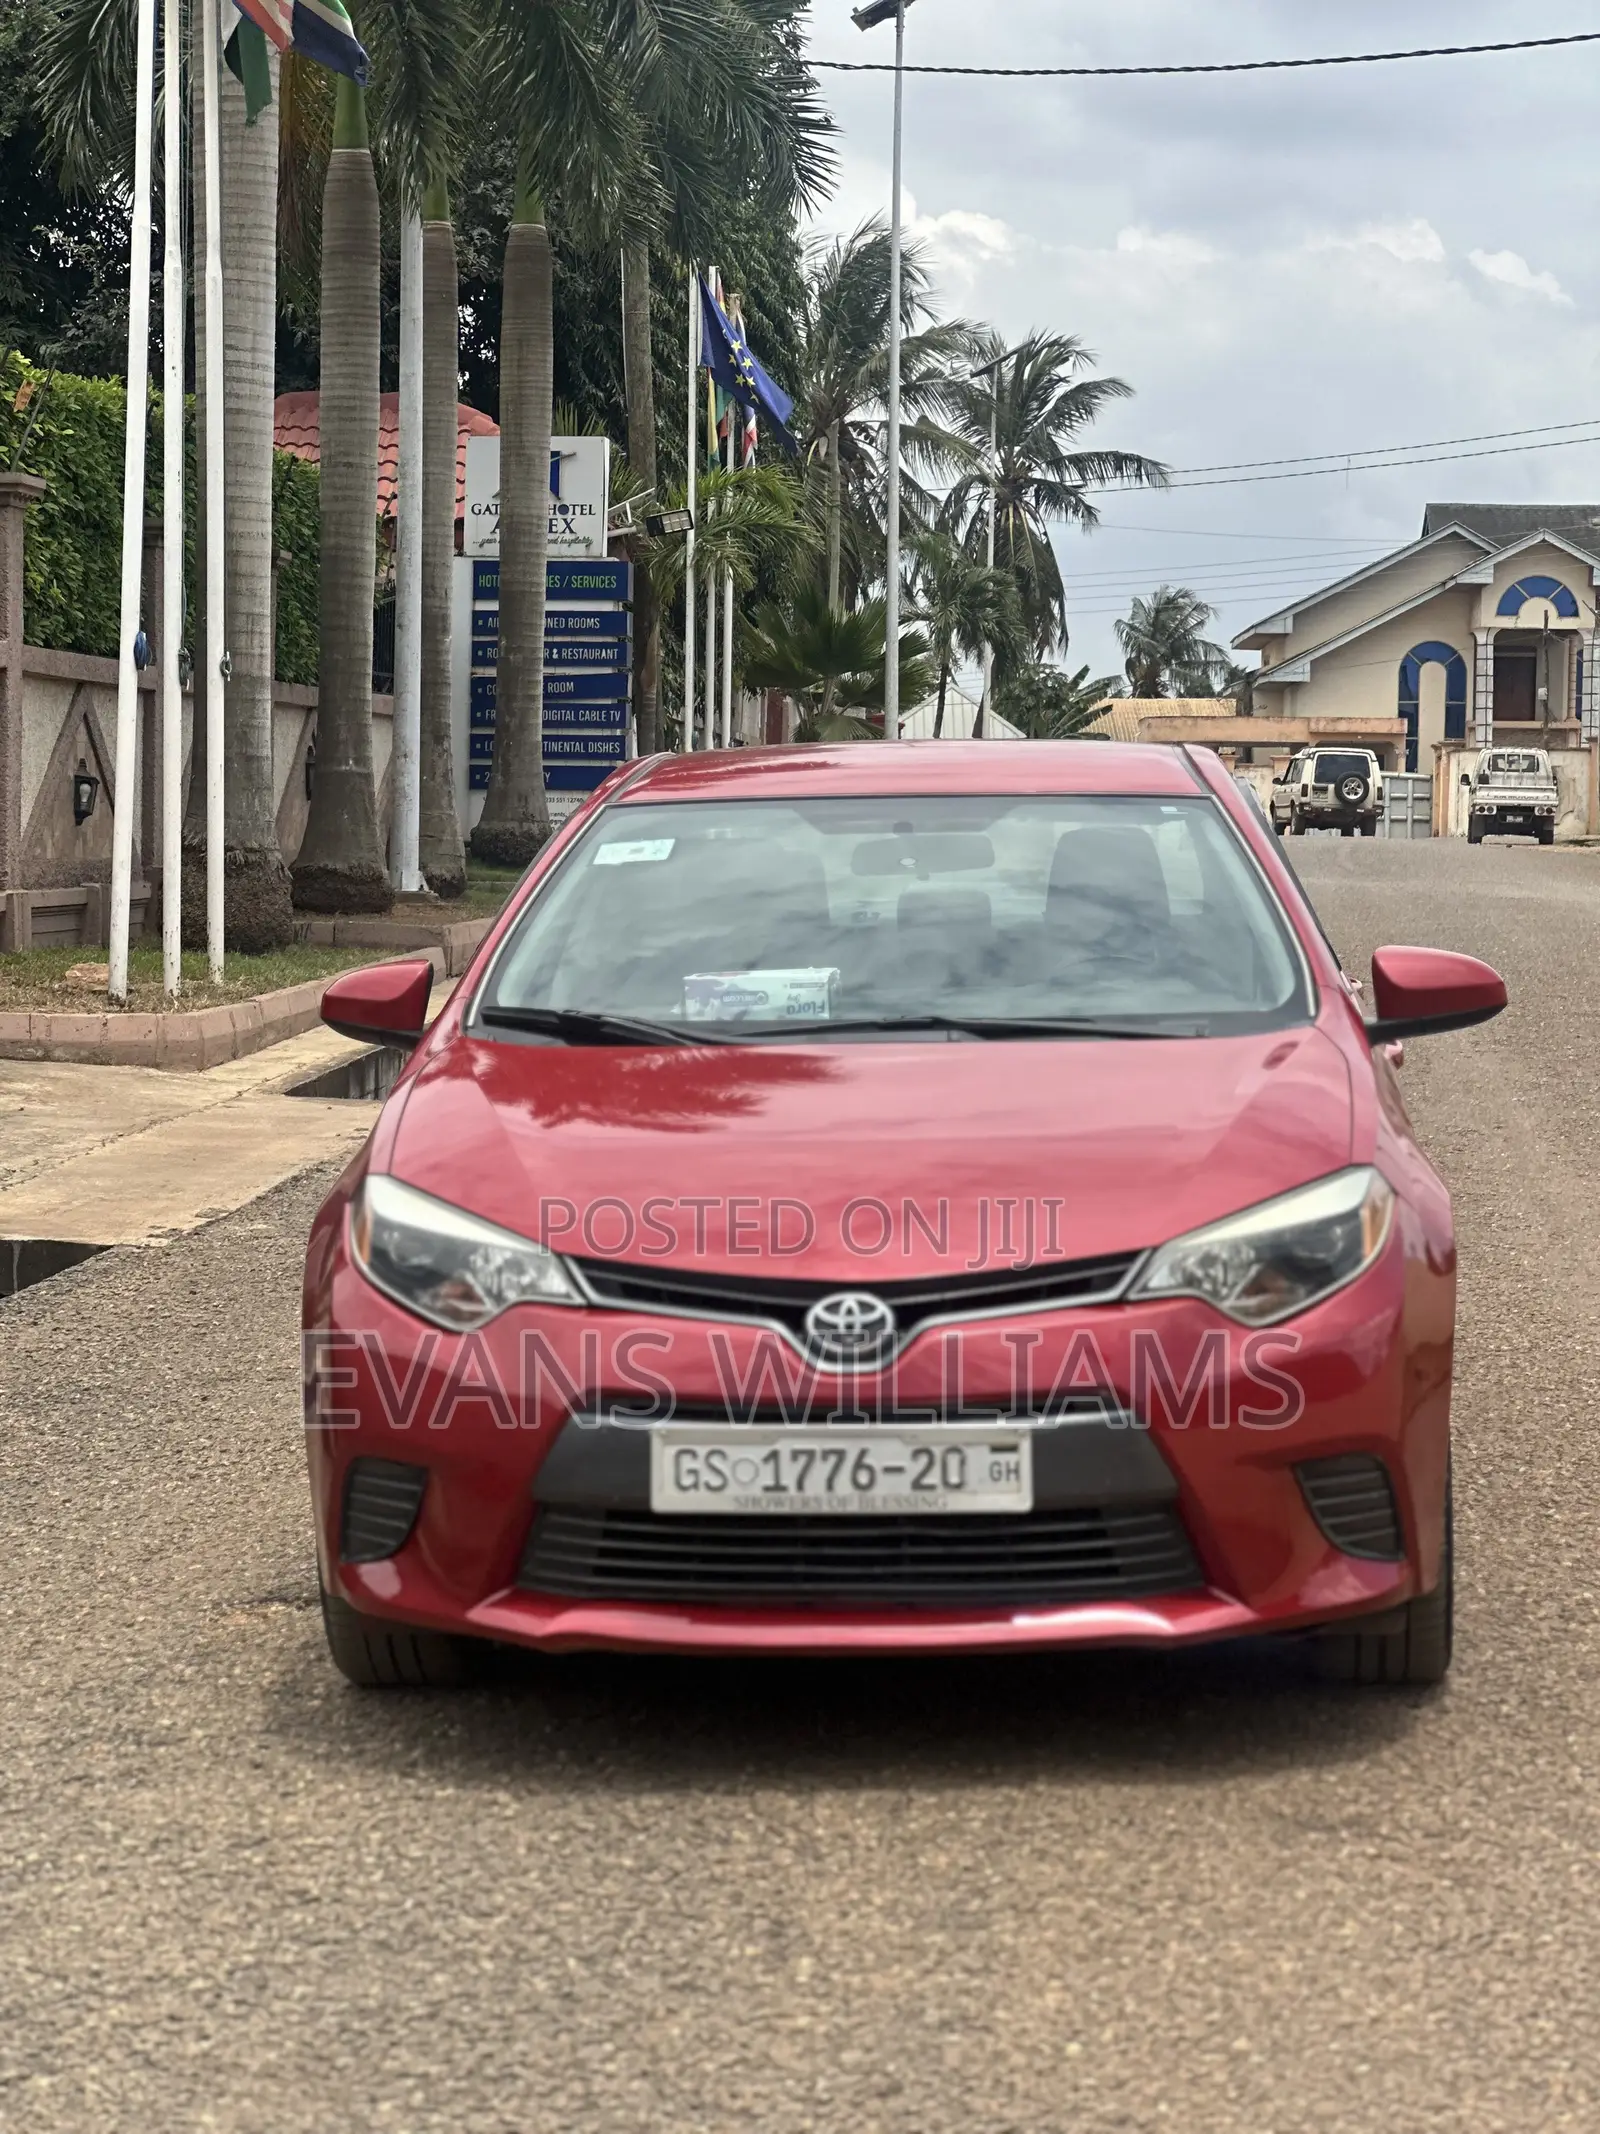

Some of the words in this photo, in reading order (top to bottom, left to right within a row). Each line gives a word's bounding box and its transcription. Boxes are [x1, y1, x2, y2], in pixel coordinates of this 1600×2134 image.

[548, 503, 597, 516] HOTEL
[571, 575, 617, 588] SERVICES
[568, 617, 600, 629] ROOMS
[552, 648, 559, 659] &
[562, 648, 619, 660] RESTAURANT
[548, 681, 574, 693] ROOM
[542, 709, 576, 722] DIGITAL
[579, 710, 606, 722] CABLE
[610, 710, 621, 722] TV
[544, 741, 586, 753] TINENTAL
[588, 742, 620, 754] DISHES
[786, 999, 826, 1016] Flora
[673, 1447, 729, 1493] GS
[761, 1447, 968, 1494] 1776-20
[988, 1460, 1021, 1482] GH
